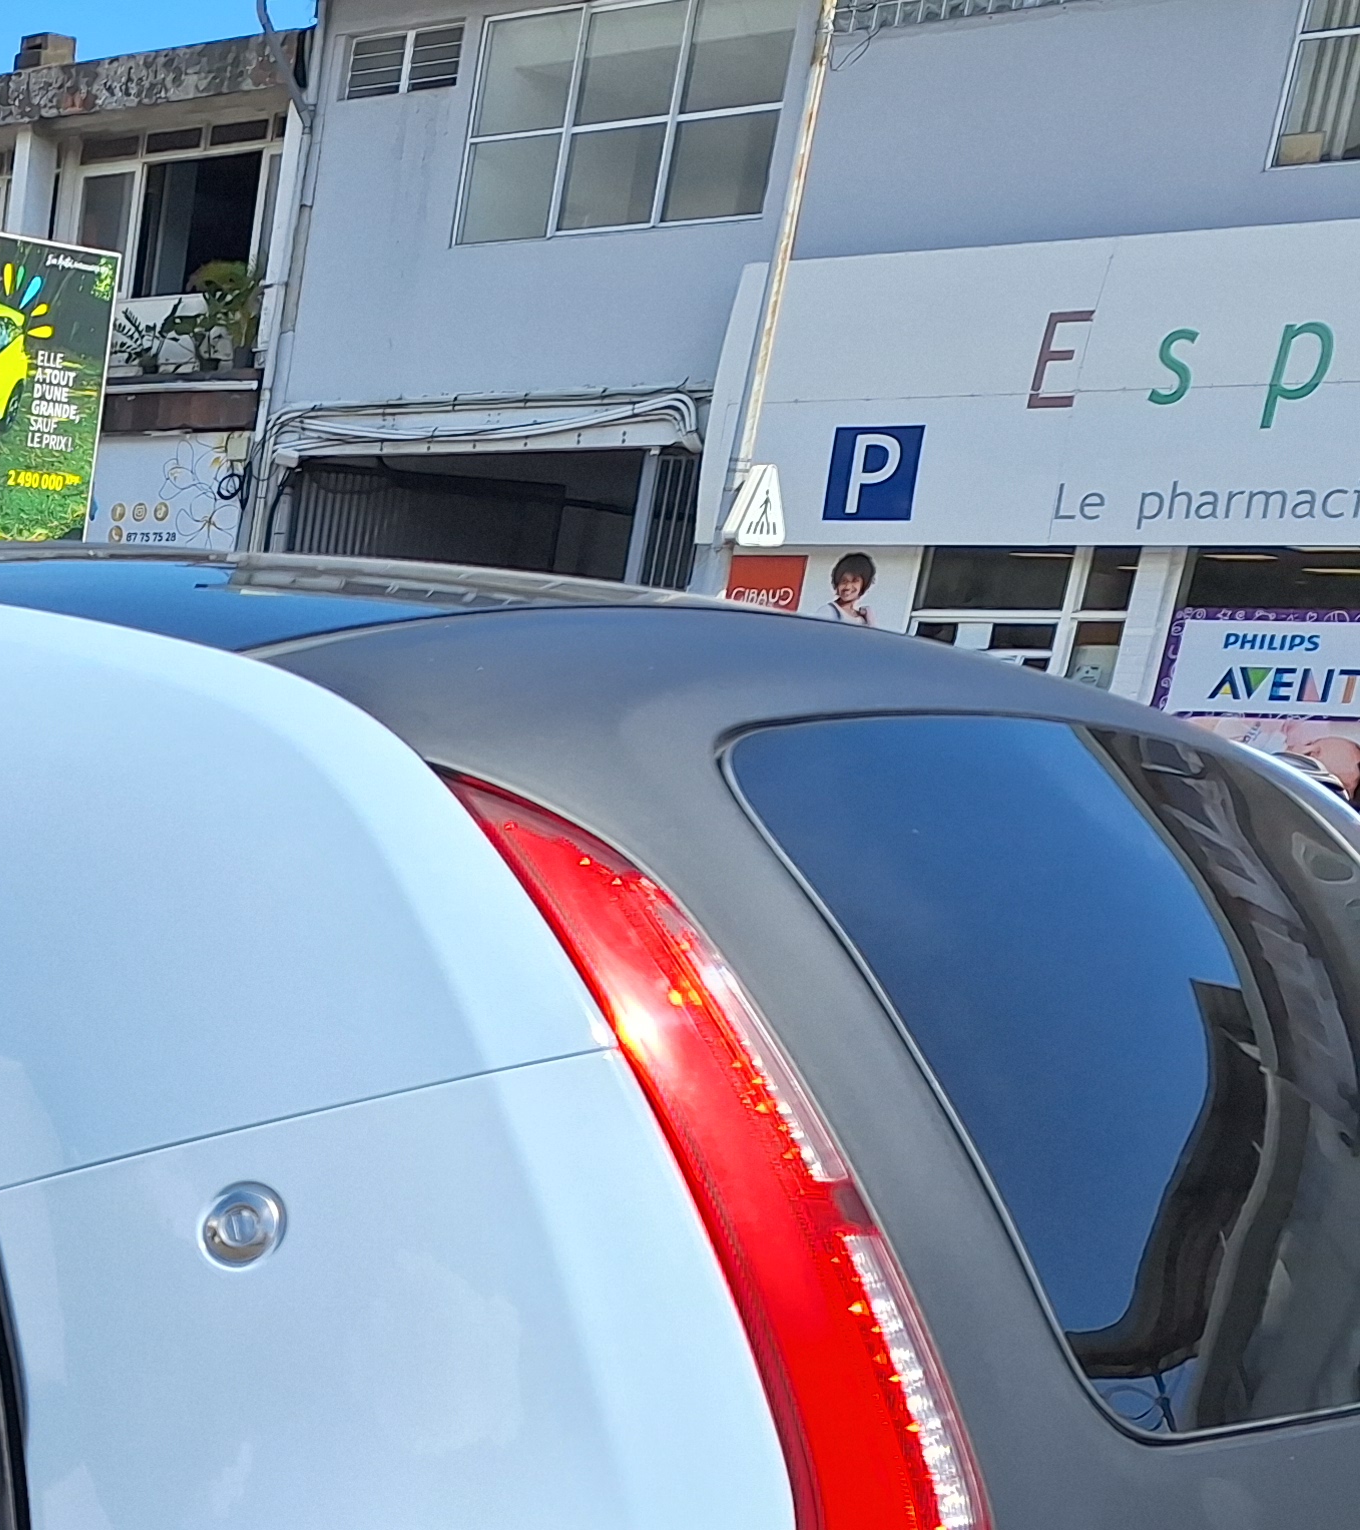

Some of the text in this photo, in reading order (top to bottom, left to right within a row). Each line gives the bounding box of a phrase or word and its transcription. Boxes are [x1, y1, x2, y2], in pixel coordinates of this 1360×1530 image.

[37, 350, 64, 368] ELLE
[33, 383, 70, 402] D'UNE
[31, 401, 80, 424] GRANDE,
[29, 416, 58, 433] SAUF
[27, 432, 40, 448] LE
[17, 471, 40, 488] 490
[41, 474, 64, 491] 000
[844, 434, 901, 515] P
[1053, 483, 1106, 520] Le
[140, 532, 150, 542] 75
[152, 532, 163, 542] 75
[1223, 633, 1320, 651] PHILIPS
[1207, 667, 1360, 704] AVENT
